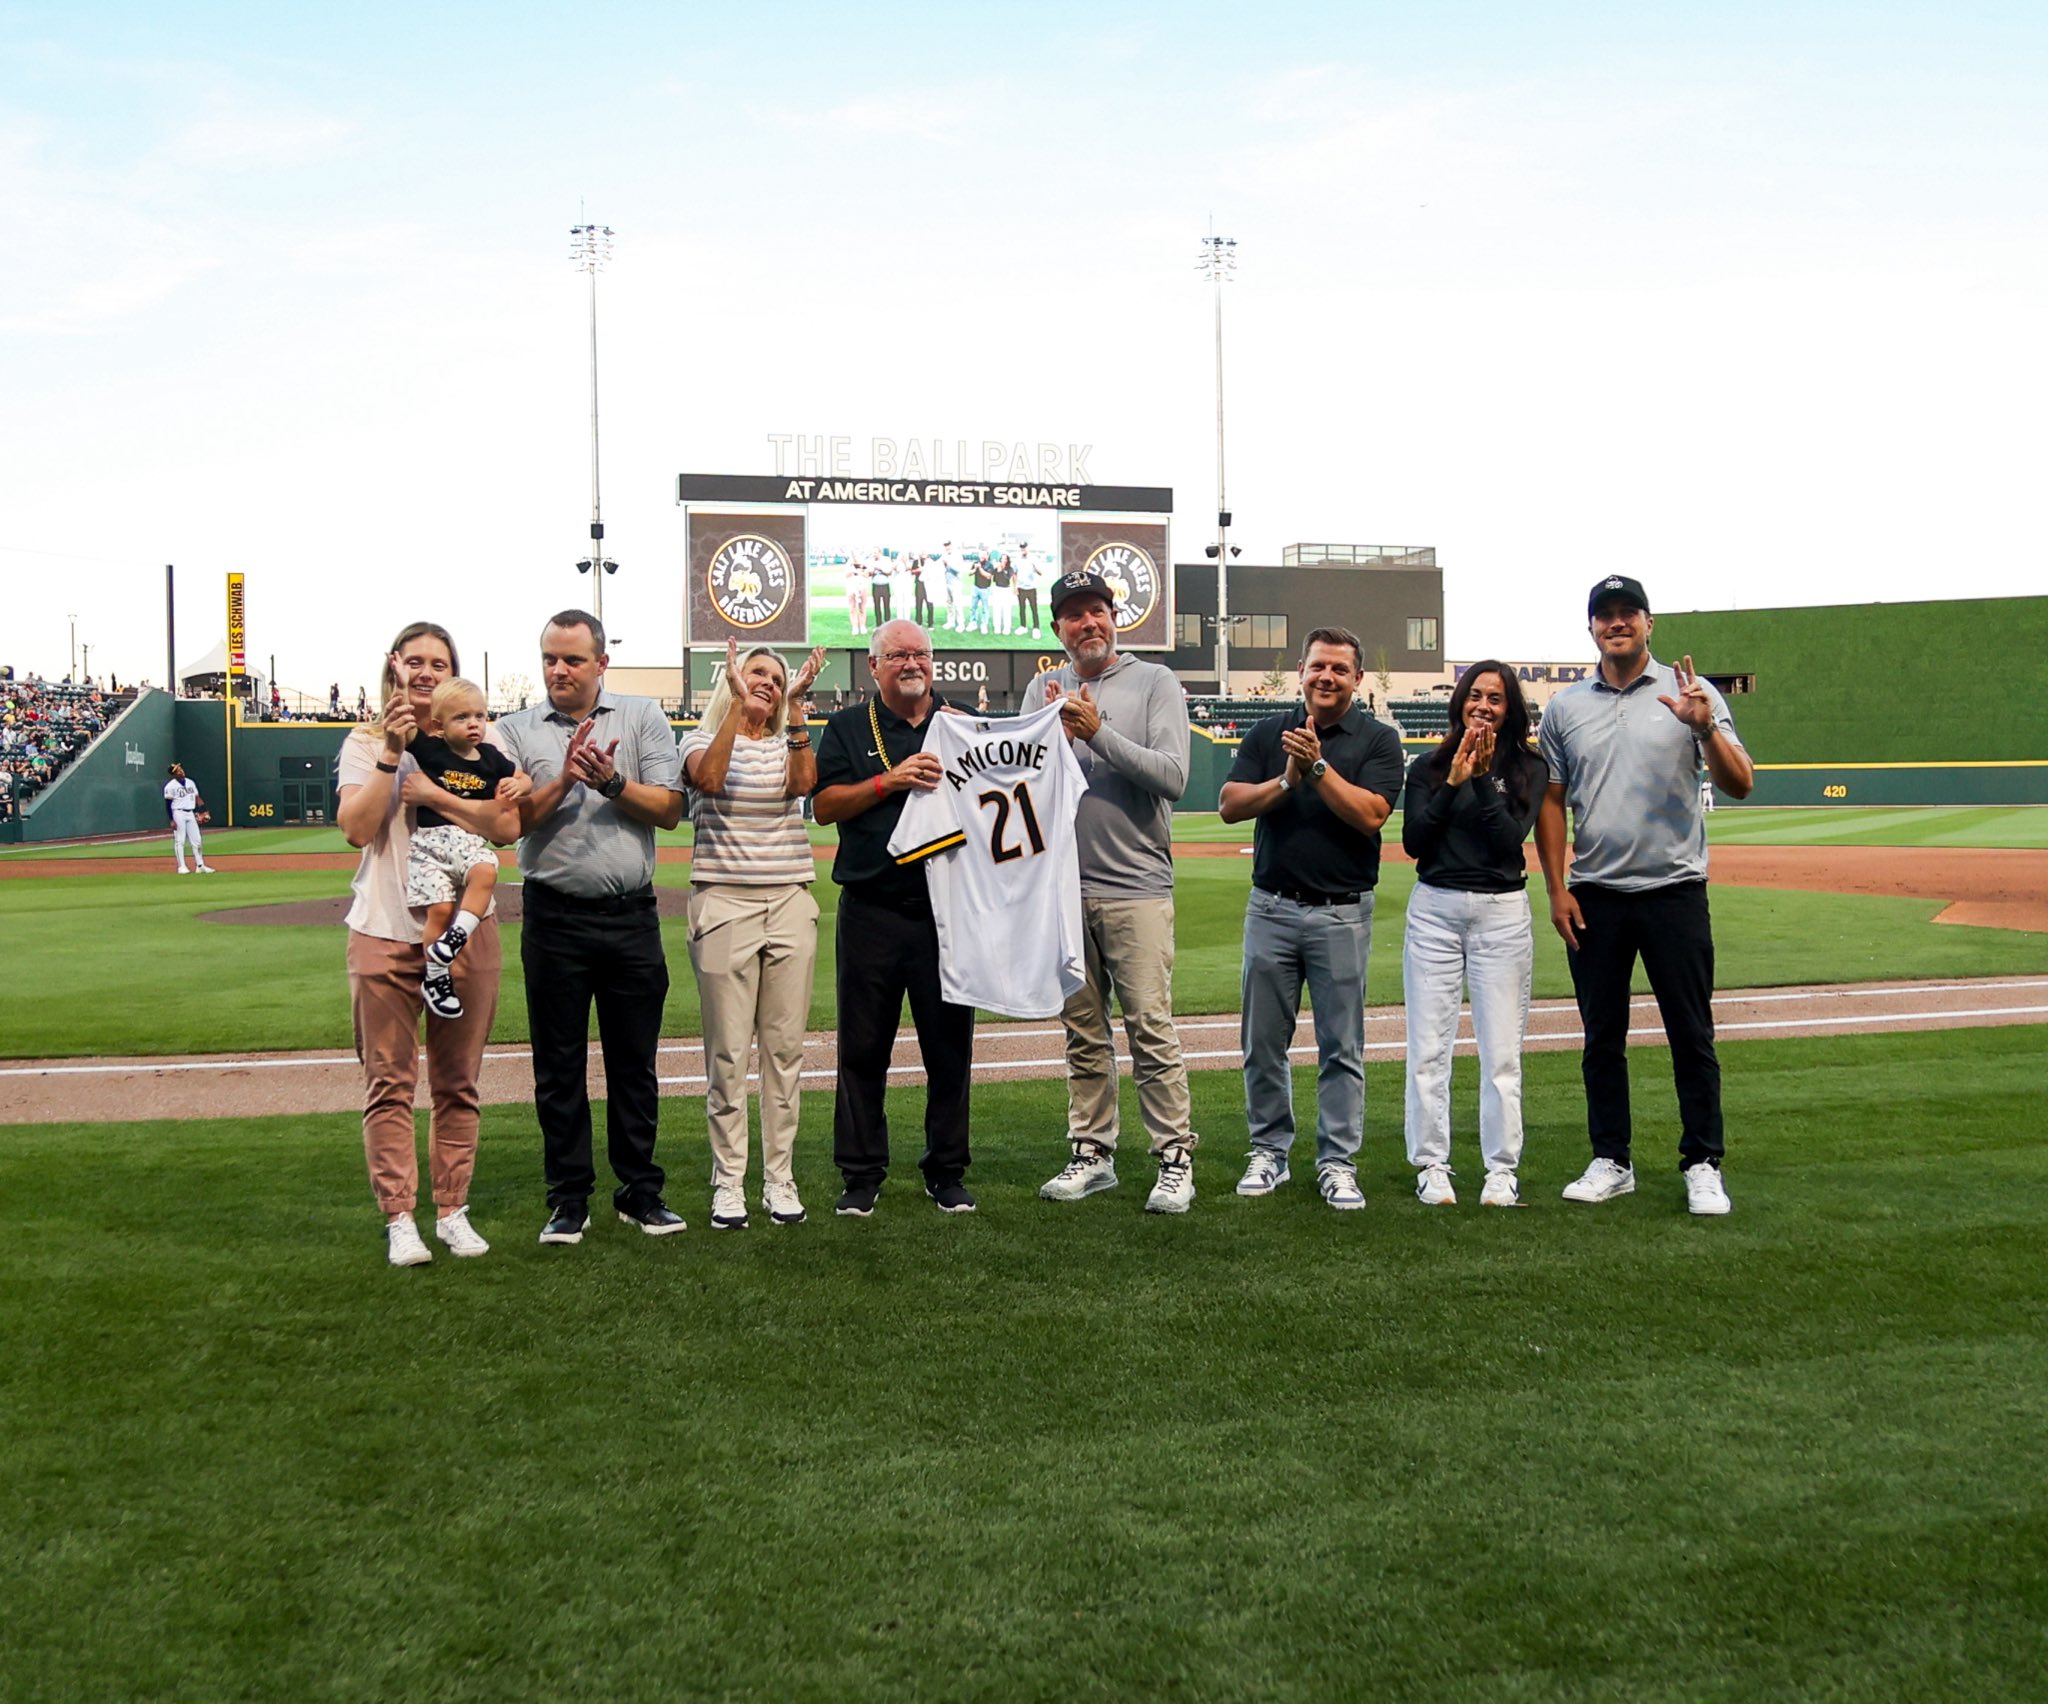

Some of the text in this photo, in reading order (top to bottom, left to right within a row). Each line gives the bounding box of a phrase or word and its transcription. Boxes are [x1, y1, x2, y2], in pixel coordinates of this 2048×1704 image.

[767, 433, 1094, 486] THE BALLPARK
[785, 480, 1081, 507] AT AMERICA FIRST SQUARE
[711, 540, 785, 587] SALT LAKE BEES
[1098, 548, 1131, 566] LAKE
[1128, 556, 1151, 593] BEES
[230, 581, 244, 650] LES SCHWAB
[718, 595, 778, 624] BASEBALL
[945, 740, 1048, 792] AMICONE
[249, 803, 274, 817] 345
[1823, 785, 1847, 798] 420
[977, 779, 1047, 866] 21
